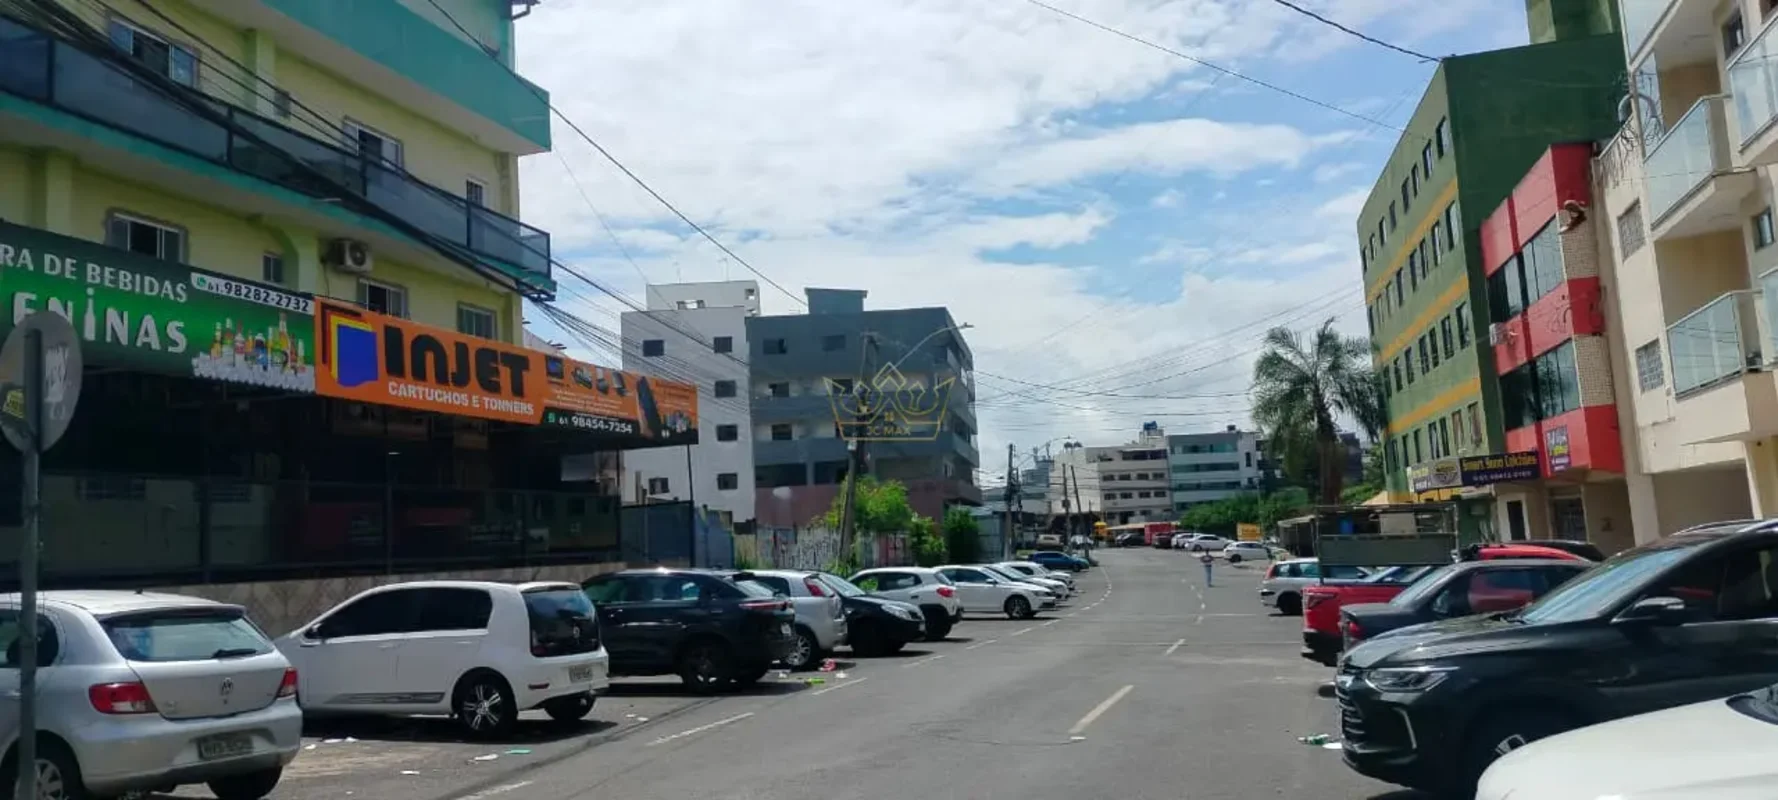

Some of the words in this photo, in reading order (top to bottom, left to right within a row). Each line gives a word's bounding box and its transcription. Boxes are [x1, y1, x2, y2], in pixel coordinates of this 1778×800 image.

[44, 253, 77, 280] DE
[86, 262, 188, 304] BEBIDAS
[383, 324, 530, 398] INJET
[388, 380, 469, 407] CARTUCHOS
[471, 395, 481, 408] E
[482, 397, 534, 416] TONNERS
